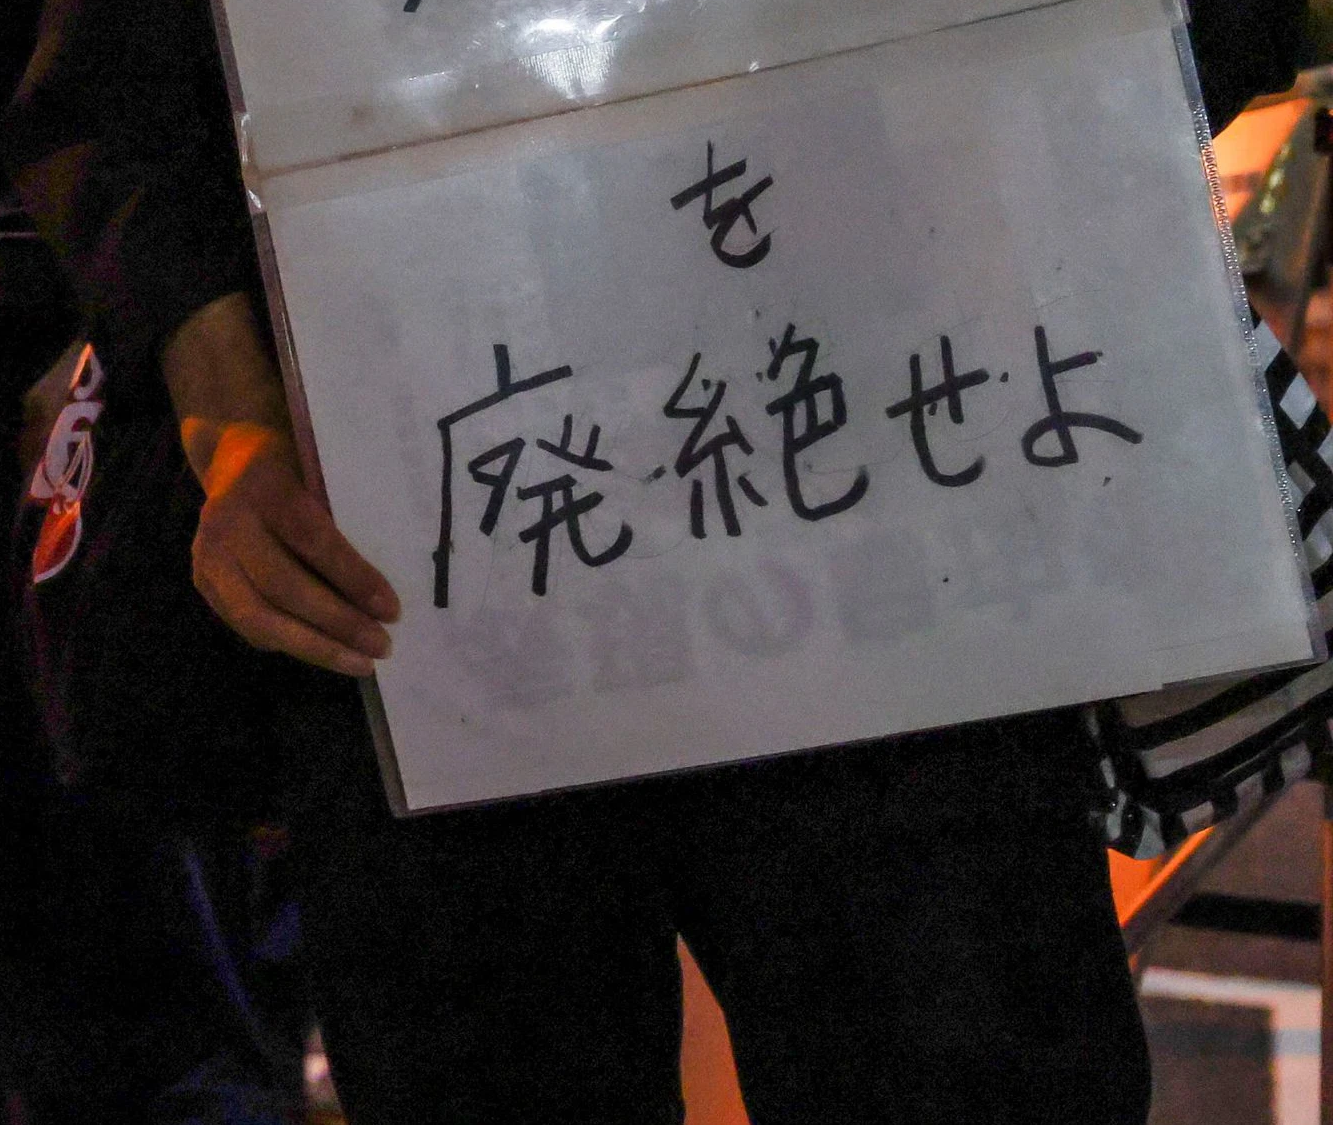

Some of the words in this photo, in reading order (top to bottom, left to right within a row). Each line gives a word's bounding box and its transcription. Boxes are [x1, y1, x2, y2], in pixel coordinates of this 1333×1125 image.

[670, 139, 775, 270] を
[433, 321, 1144, 609] 廃絶せよ
